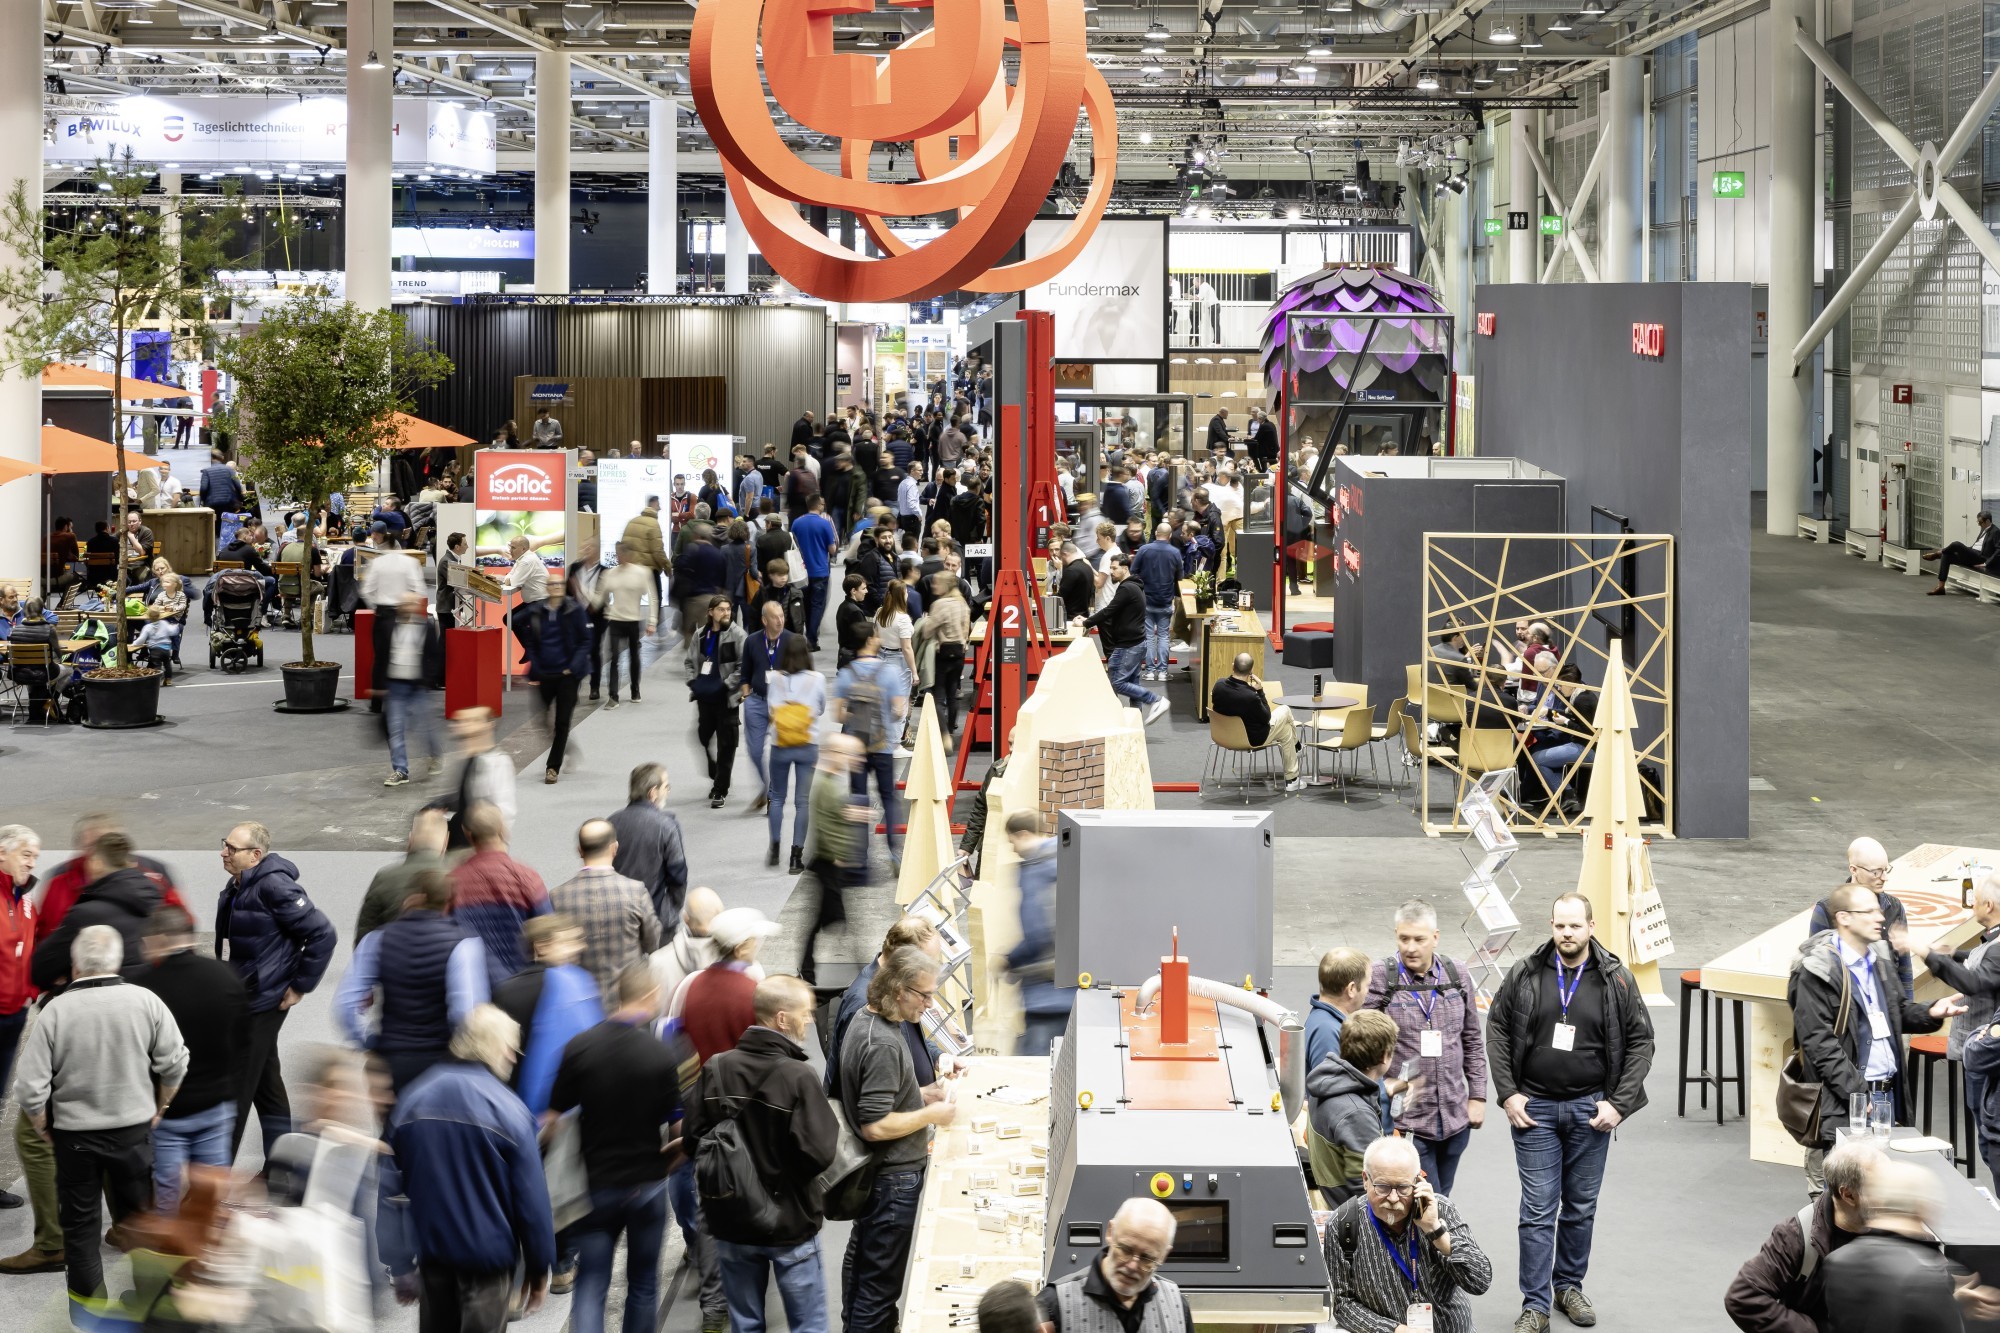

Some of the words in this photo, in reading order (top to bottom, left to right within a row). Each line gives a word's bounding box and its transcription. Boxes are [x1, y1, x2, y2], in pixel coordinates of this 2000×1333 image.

[193, 121, 305, 134] Tageslichttechniken
[483, 239, 520, 248] HOLCIM
[1048, 282, 1140, 296] Fundermax
[1632, 322, 1662, 356] RAICO
[1898, 387, 1909, 401] F
[1038, 505, 1047, 522] 1
[1002, 605, 1019, 629] 2
